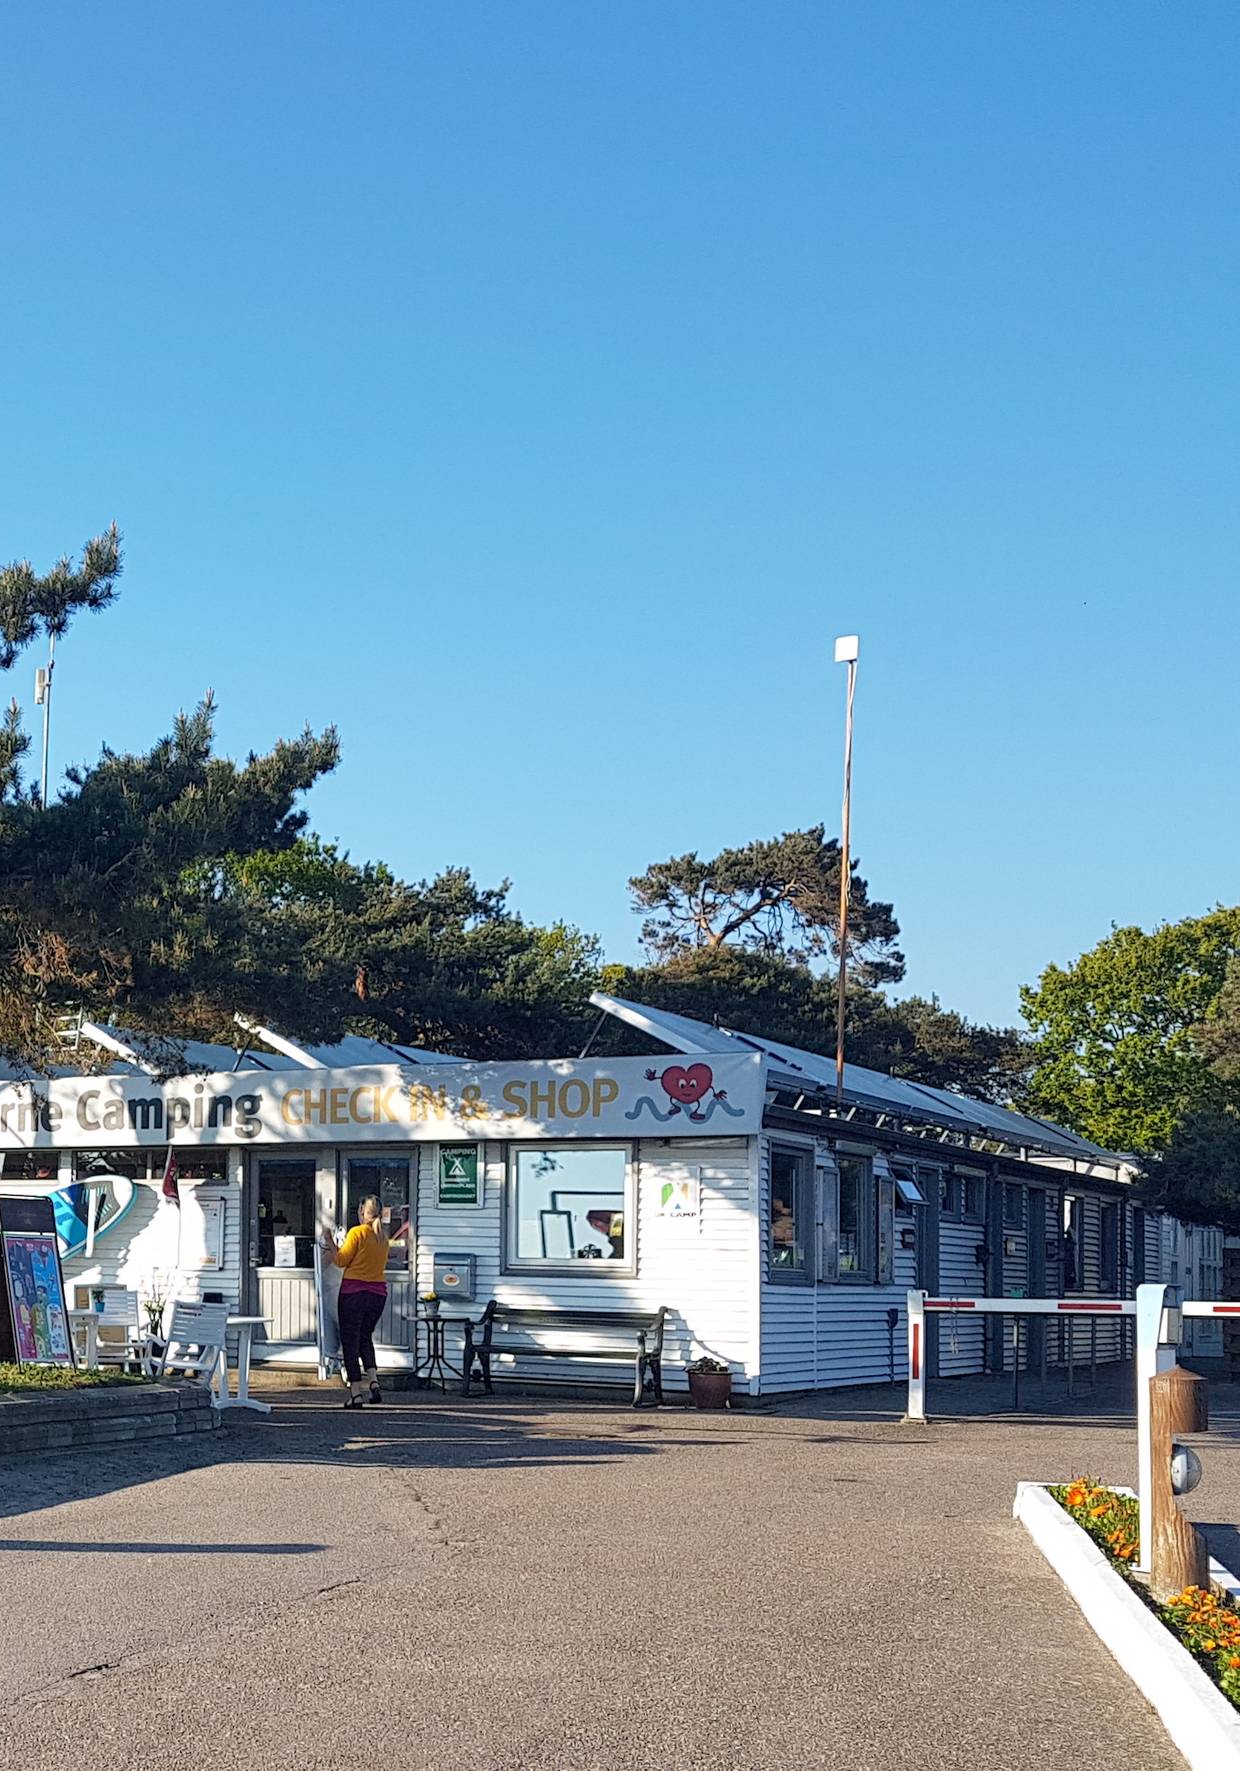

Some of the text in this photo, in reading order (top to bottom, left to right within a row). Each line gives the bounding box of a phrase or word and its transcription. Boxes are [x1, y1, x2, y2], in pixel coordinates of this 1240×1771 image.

[76, 1083, 263, 1139] Camping
[281, 1078, 620, 1126] CHECK IN & SHOP
